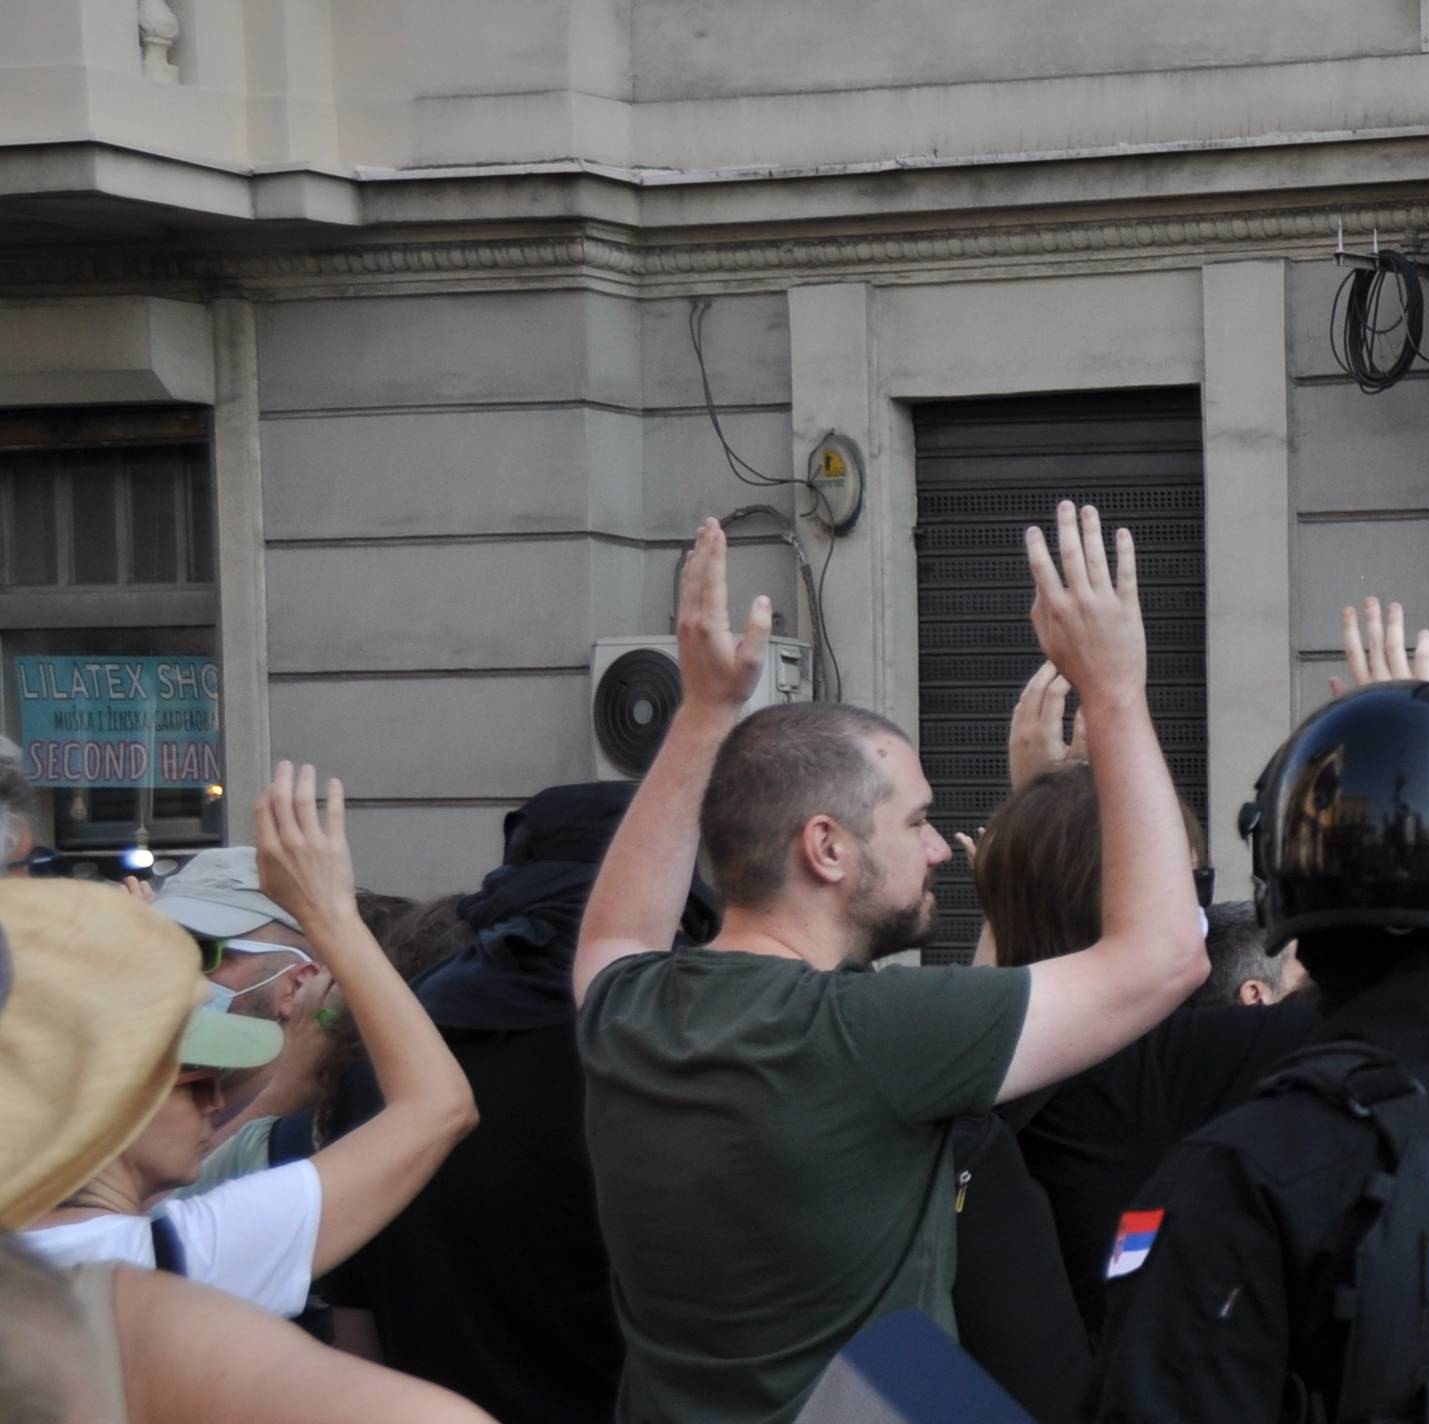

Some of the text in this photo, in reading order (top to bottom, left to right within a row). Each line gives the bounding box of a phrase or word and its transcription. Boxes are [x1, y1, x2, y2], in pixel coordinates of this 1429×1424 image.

[18, 662, 148, 699] LILATEX
[54, 705, 94, 732] MUŠKA
[99, 710, 106, 732] I
[107, 705, 148, 733] ŽENSKA
[29, 741, 148, 782] SECOND
